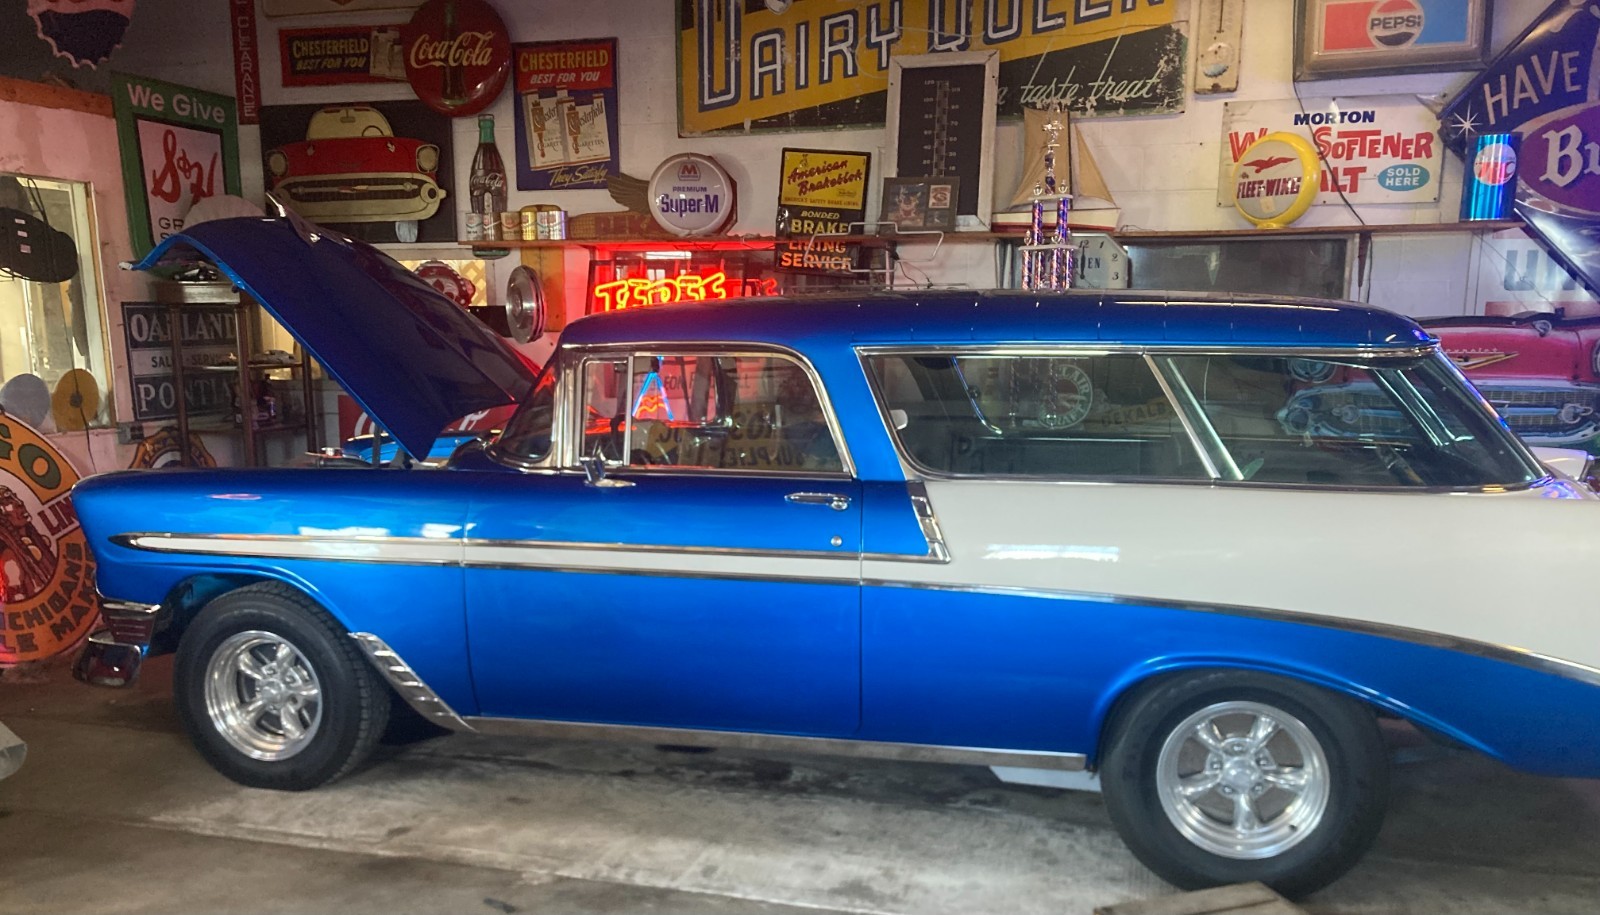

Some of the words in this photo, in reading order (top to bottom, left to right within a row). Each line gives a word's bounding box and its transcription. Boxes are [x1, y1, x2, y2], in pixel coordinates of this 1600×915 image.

[292, 38, 369, 58] CHESTERFIELD
[237, 16, 257, 117] CLEARANCE
[296, 58, 319, 70] BEST
[321, 57, 342, 69] FOR
[344, 56, 367, 68] YOU
[520, 49, 609, 73] CHESTERFIELD
[1020, 42, 1077, 104] taste
[1088, 33, 1167, 100] treat
[530, 73, 556, 85] BEST
[557, 72, 576, 83] FOR
[580, 71, 601, 82] YOU
[1483, 51, 1582, 125] HAVE
[127, 82, 165, 112] We
[172, 93, 226, 123] Give
[1293, 110, 1376, 126] MORTON
[1313, 126, 1434, 161] SOFTENER
[1387, 168, 1421, 177] SOLD
[1385, 177, 1420, 186] HERE
[801, 210, 840, 220] BONDED
[790, 218, 849, 235] BRAKE
[1079, 240, 1090, 249] 12
[781, 252, 852, 270] SERVICE
[1112, 271, 1120, 281] 3
